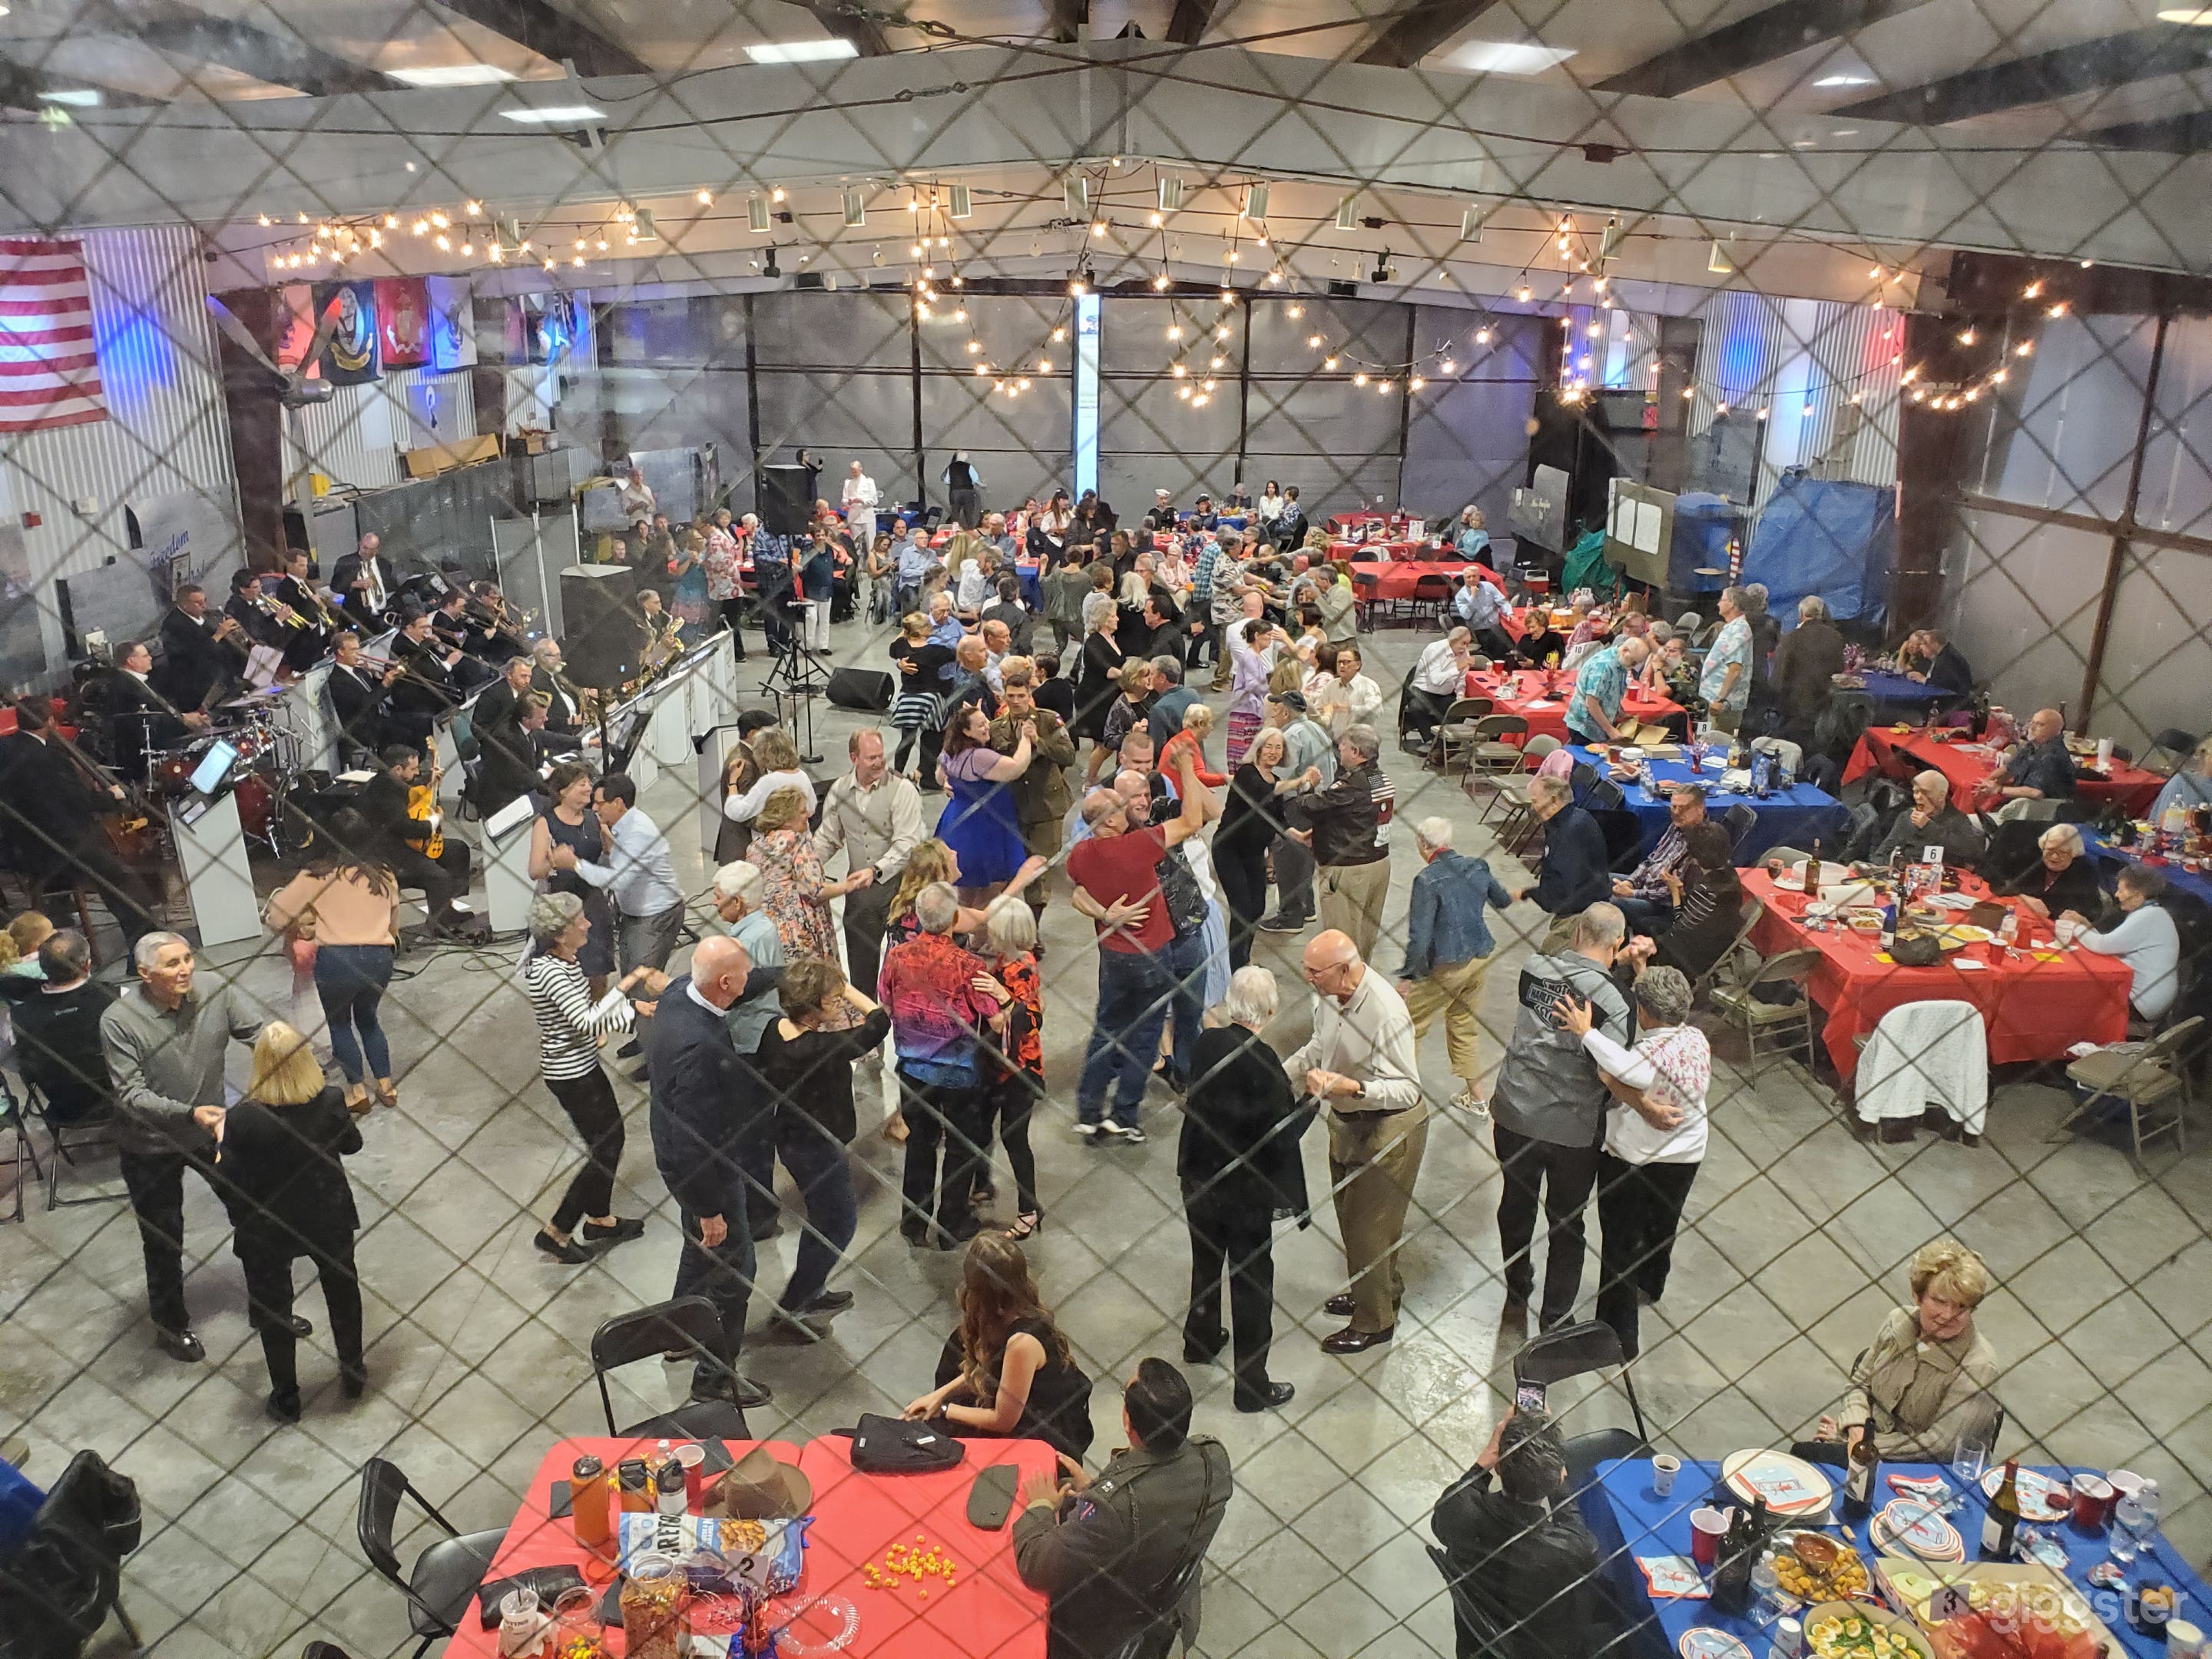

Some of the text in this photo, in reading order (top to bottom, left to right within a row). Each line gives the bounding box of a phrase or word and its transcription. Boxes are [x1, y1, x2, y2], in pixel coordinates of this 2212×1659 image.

[1701, 724, 1707, 733] 8
[1930, 849, 1937, 860] 6
[740, 1557, 755, 1578] 2
[1943, 1590, 1957, 1614] 3
